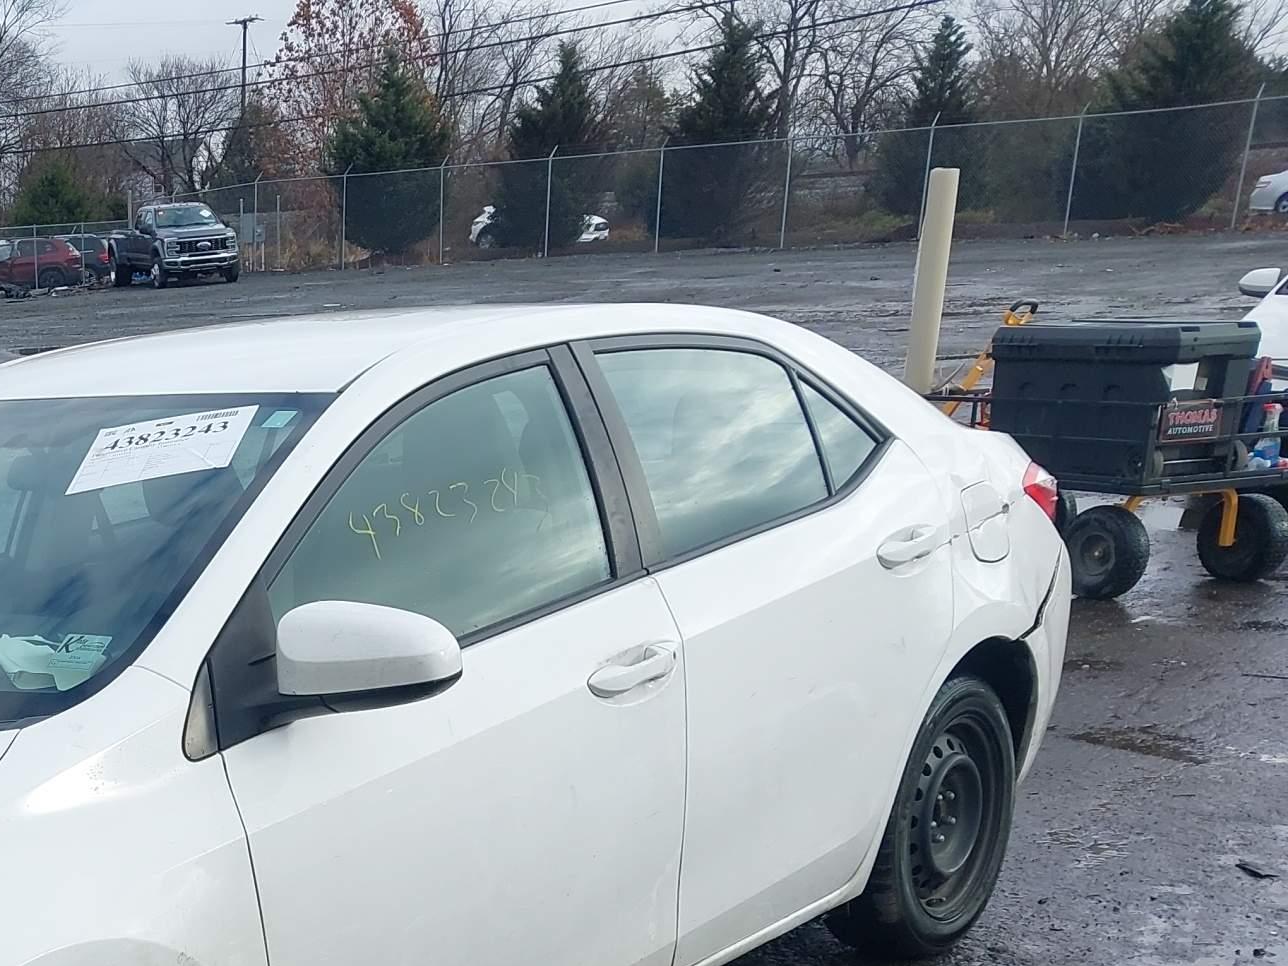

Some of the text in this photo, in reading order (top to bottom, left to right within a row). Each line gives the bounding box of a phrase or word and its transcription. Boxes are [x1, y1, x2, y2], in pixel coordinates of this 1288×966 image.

[1168, 409, 1217, 425] THOMAS
[103, 421, 230, 451] 43823243
[1167, 424, 1214, 435] AUTOMOTIVE
